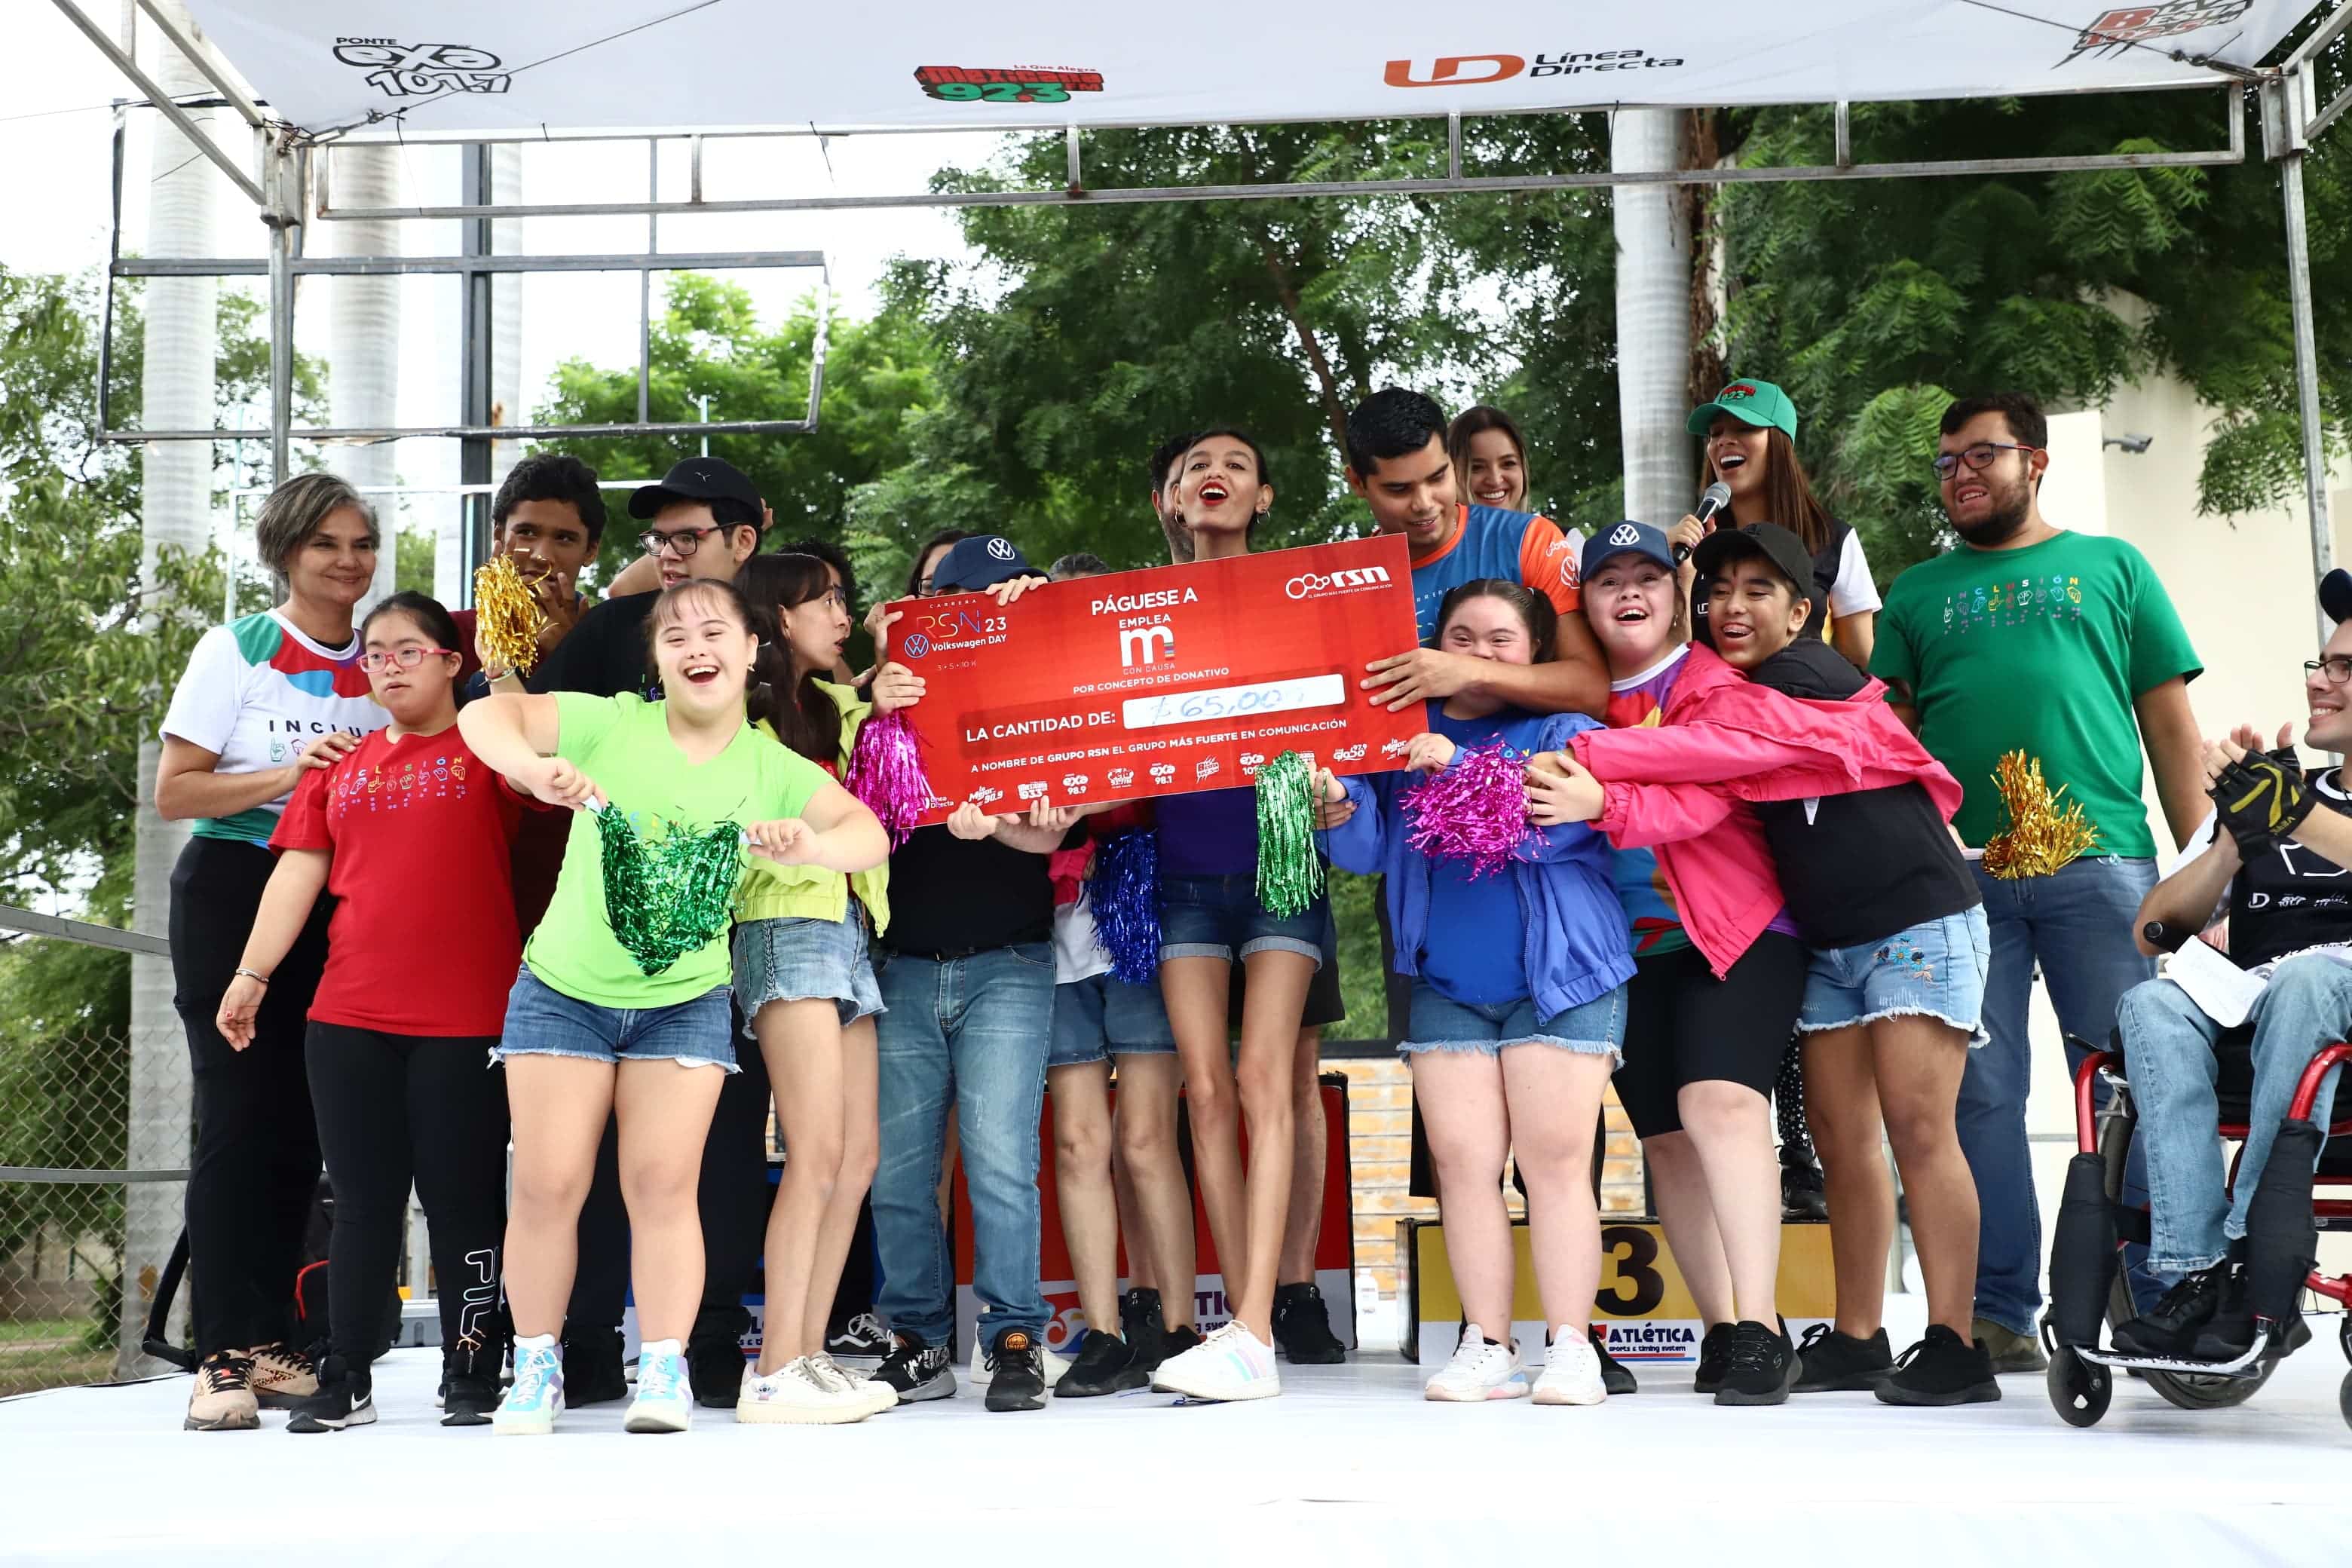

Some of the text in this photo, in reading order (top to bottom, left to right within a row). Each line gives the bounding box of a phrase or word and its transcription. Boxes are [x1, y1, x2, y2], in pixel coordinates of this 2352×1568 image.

[1535, 49, 1643, 65] Línea
[1530, 57, 1684, 78] Directa
[365, 69, 512, 96] 101.7
[1092, 587, 1199, 616] PÁGUESE A
[985, 616, 1007, 632] 23
[1119, 614, 1171, 629] EMPLEA
[931, 633, 1007, 652] Volkswagen DAY
[1123, 663, 1176, 675] CON CAUSA
[1073, 667, 1230, 694] POR CONCEPTO DE DONATIVO
[966, 711, 1116, 743] LA CANTIDAD DE:
[971, 718, 1347, 773] A NOMBRE DE GRUPO RSN EL GRUPO MÁS FUERTE EN COMUNICACIÓN
[1154, 776, 1172, 785] 98.1
[1067, 786, 1086, 795] 98.9
[1594, 1227, 1664, 1316] 3
[1639, 1344, 1660, 1353] timing
